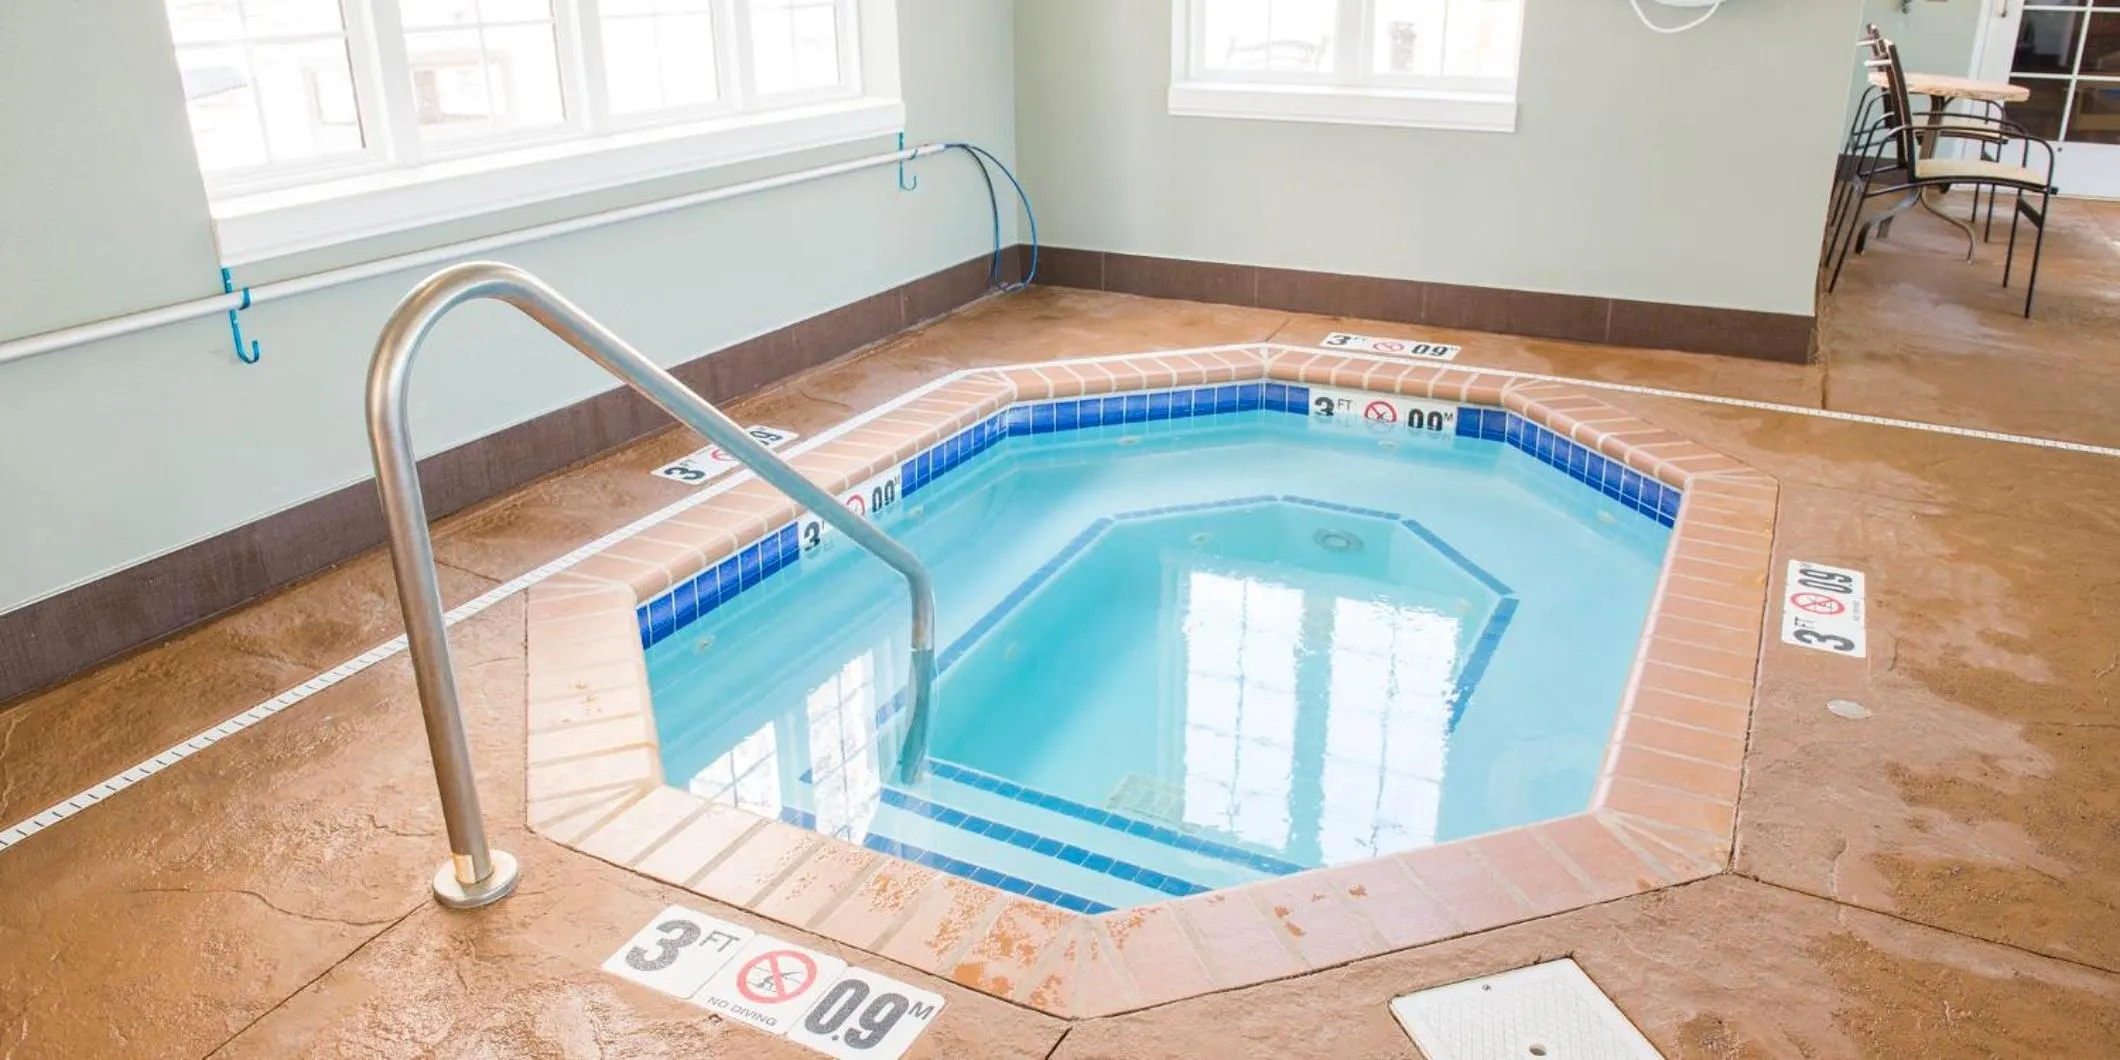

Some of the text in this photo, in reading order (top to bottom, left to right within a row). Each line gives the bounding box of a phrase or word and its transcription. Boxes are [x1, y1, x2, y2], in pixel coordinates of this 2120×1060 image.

[1327, 335, 1351, 346] 3
[1315, 397, 1334, 416] 3
[1338, 398, 1352, 410] FT
[664, 467, 705, 480] 3
[804, 521, 820, 552] 3
[1793, 629, 1855, 651] 3
[625, 919, 934, 1050] 3 FT 0.9 M
[708, 996, 778, 1027] NO DIVING
